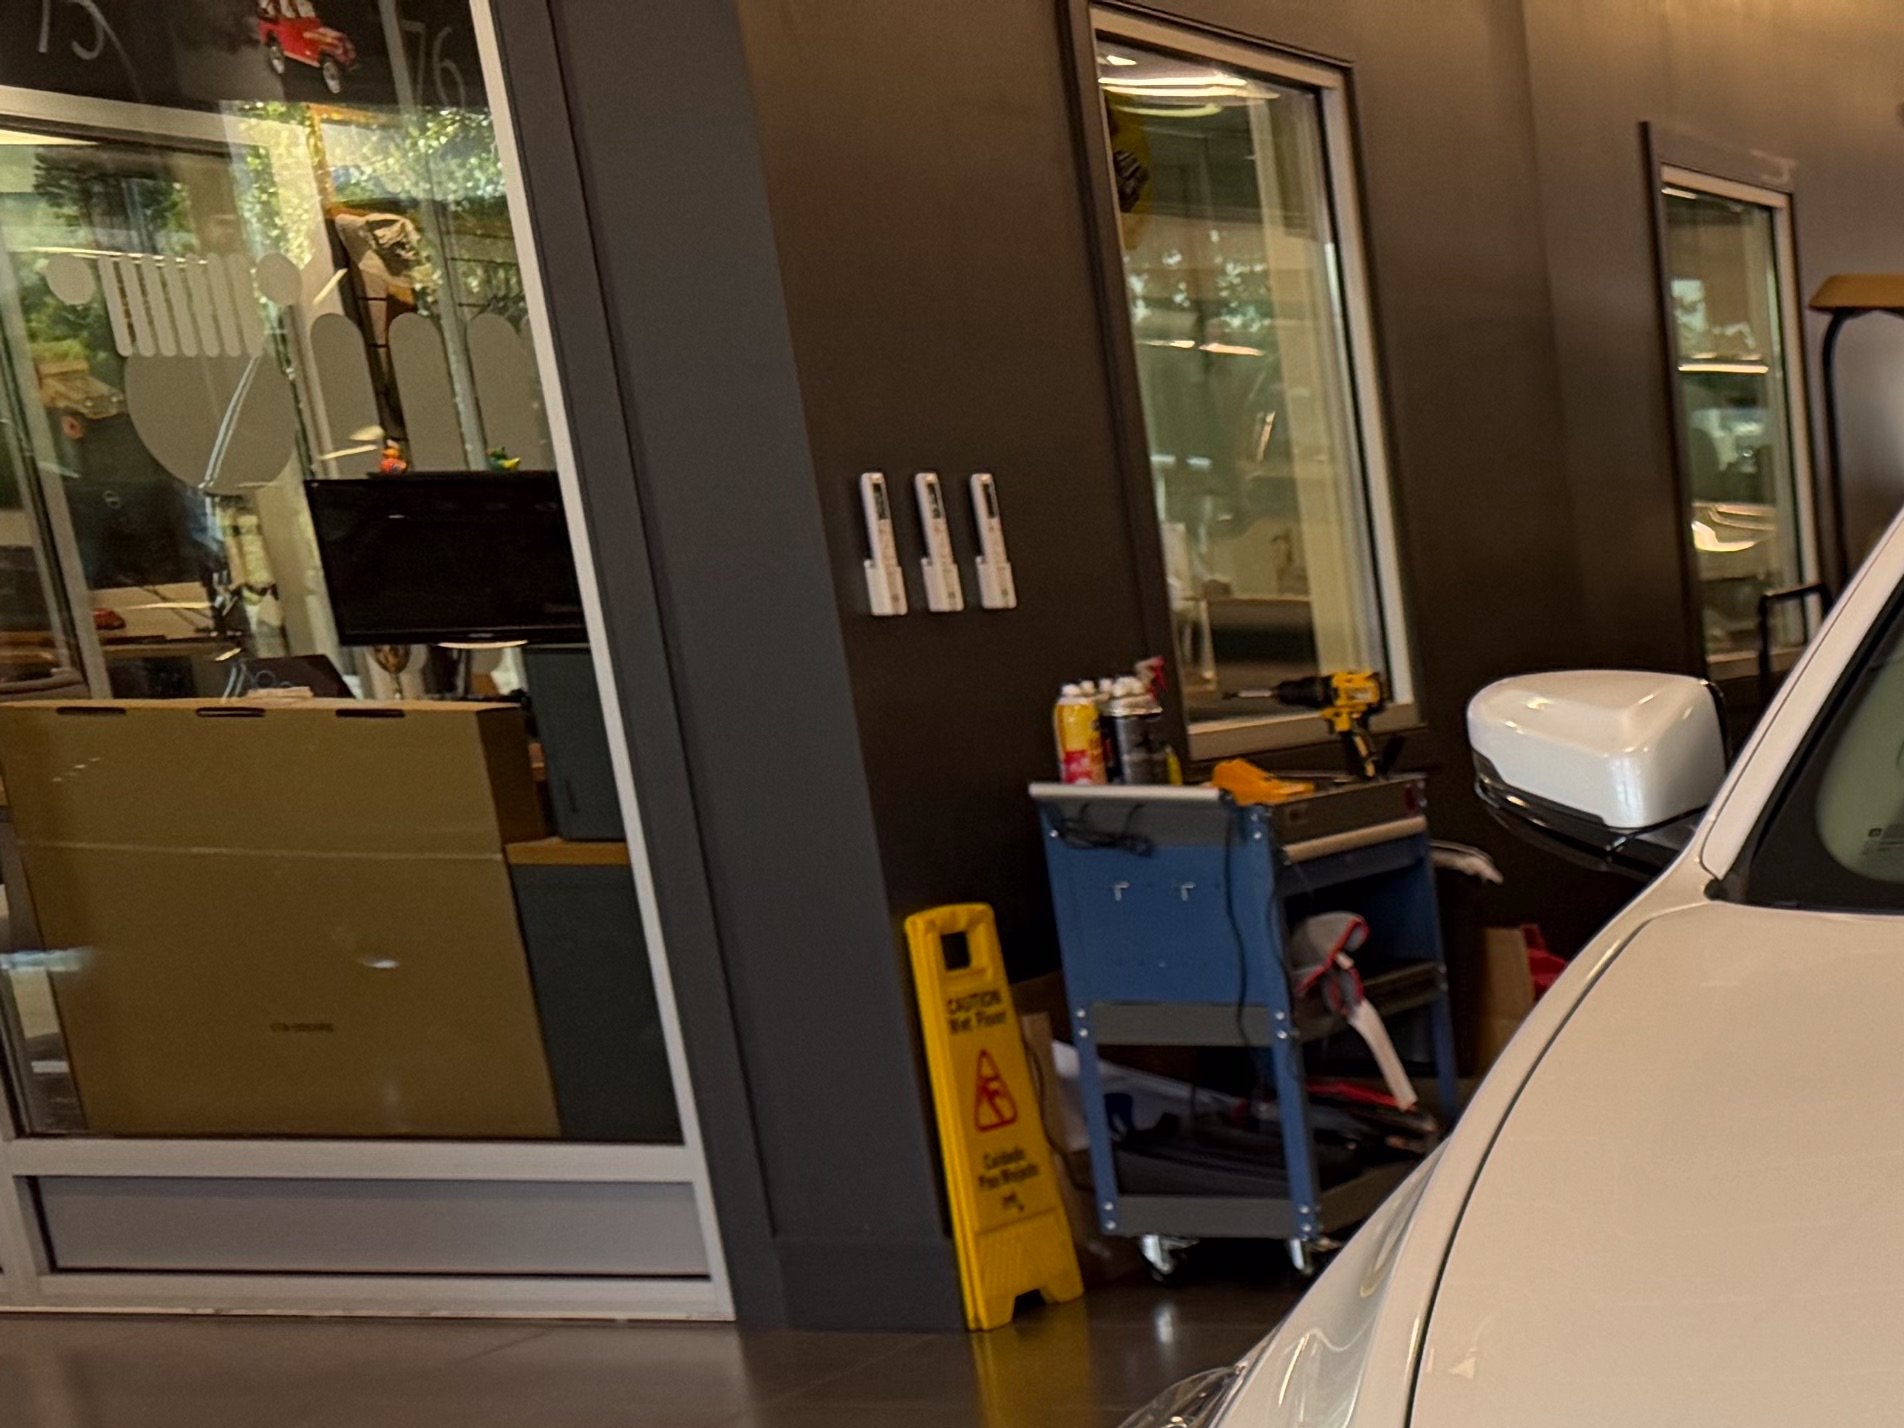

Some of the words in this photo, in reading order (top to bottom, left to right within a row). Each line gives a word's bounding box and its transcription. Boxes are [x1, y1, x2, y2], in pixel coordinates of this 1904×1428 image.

[947, 990, 1002, 1016] CAUTION
[950, 1016, 972, 1034] Wet
[975, 1009, 1006, 1029] Floor
